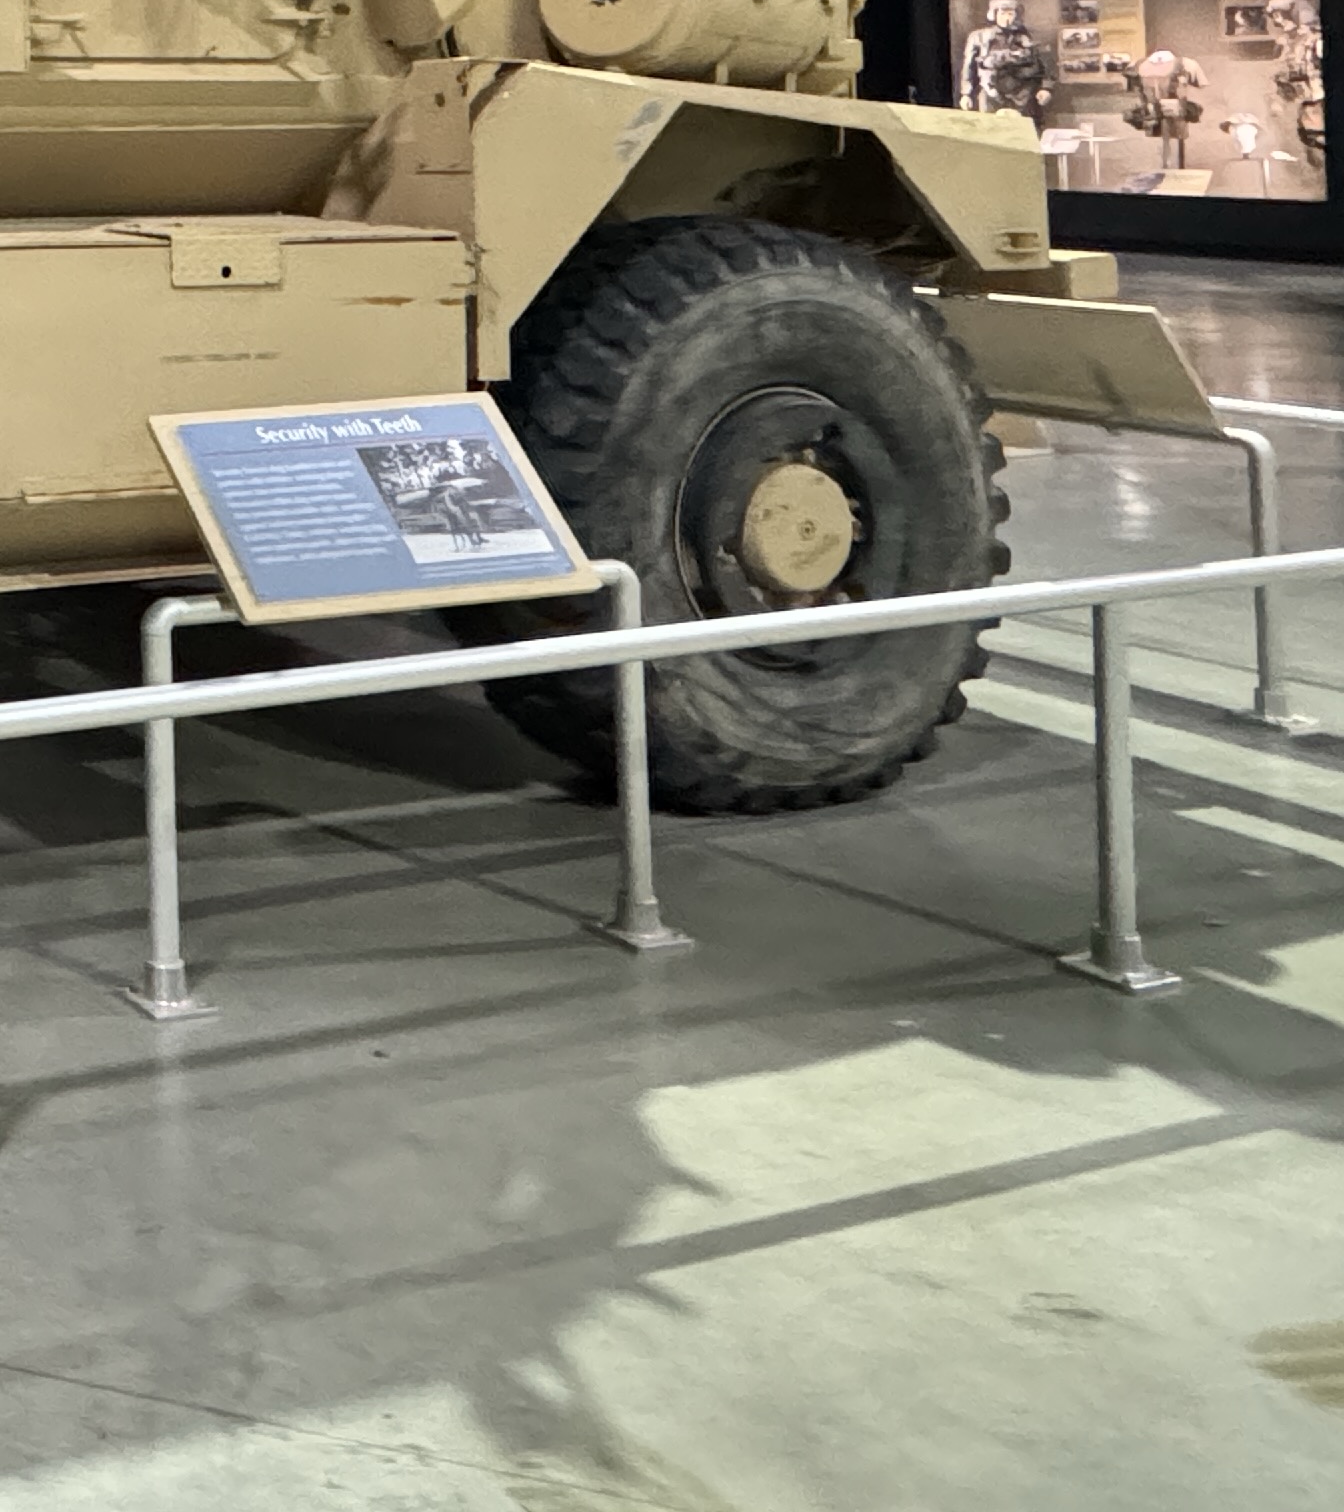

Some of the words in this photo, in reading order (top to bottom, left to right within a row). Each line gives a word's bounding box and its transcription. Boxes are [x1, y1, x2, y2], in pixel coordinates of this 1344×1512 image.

[255, 422, 329, 444] Security
[330, 418, 374, 438] with
[370, 414, 423, 435] Teeth
